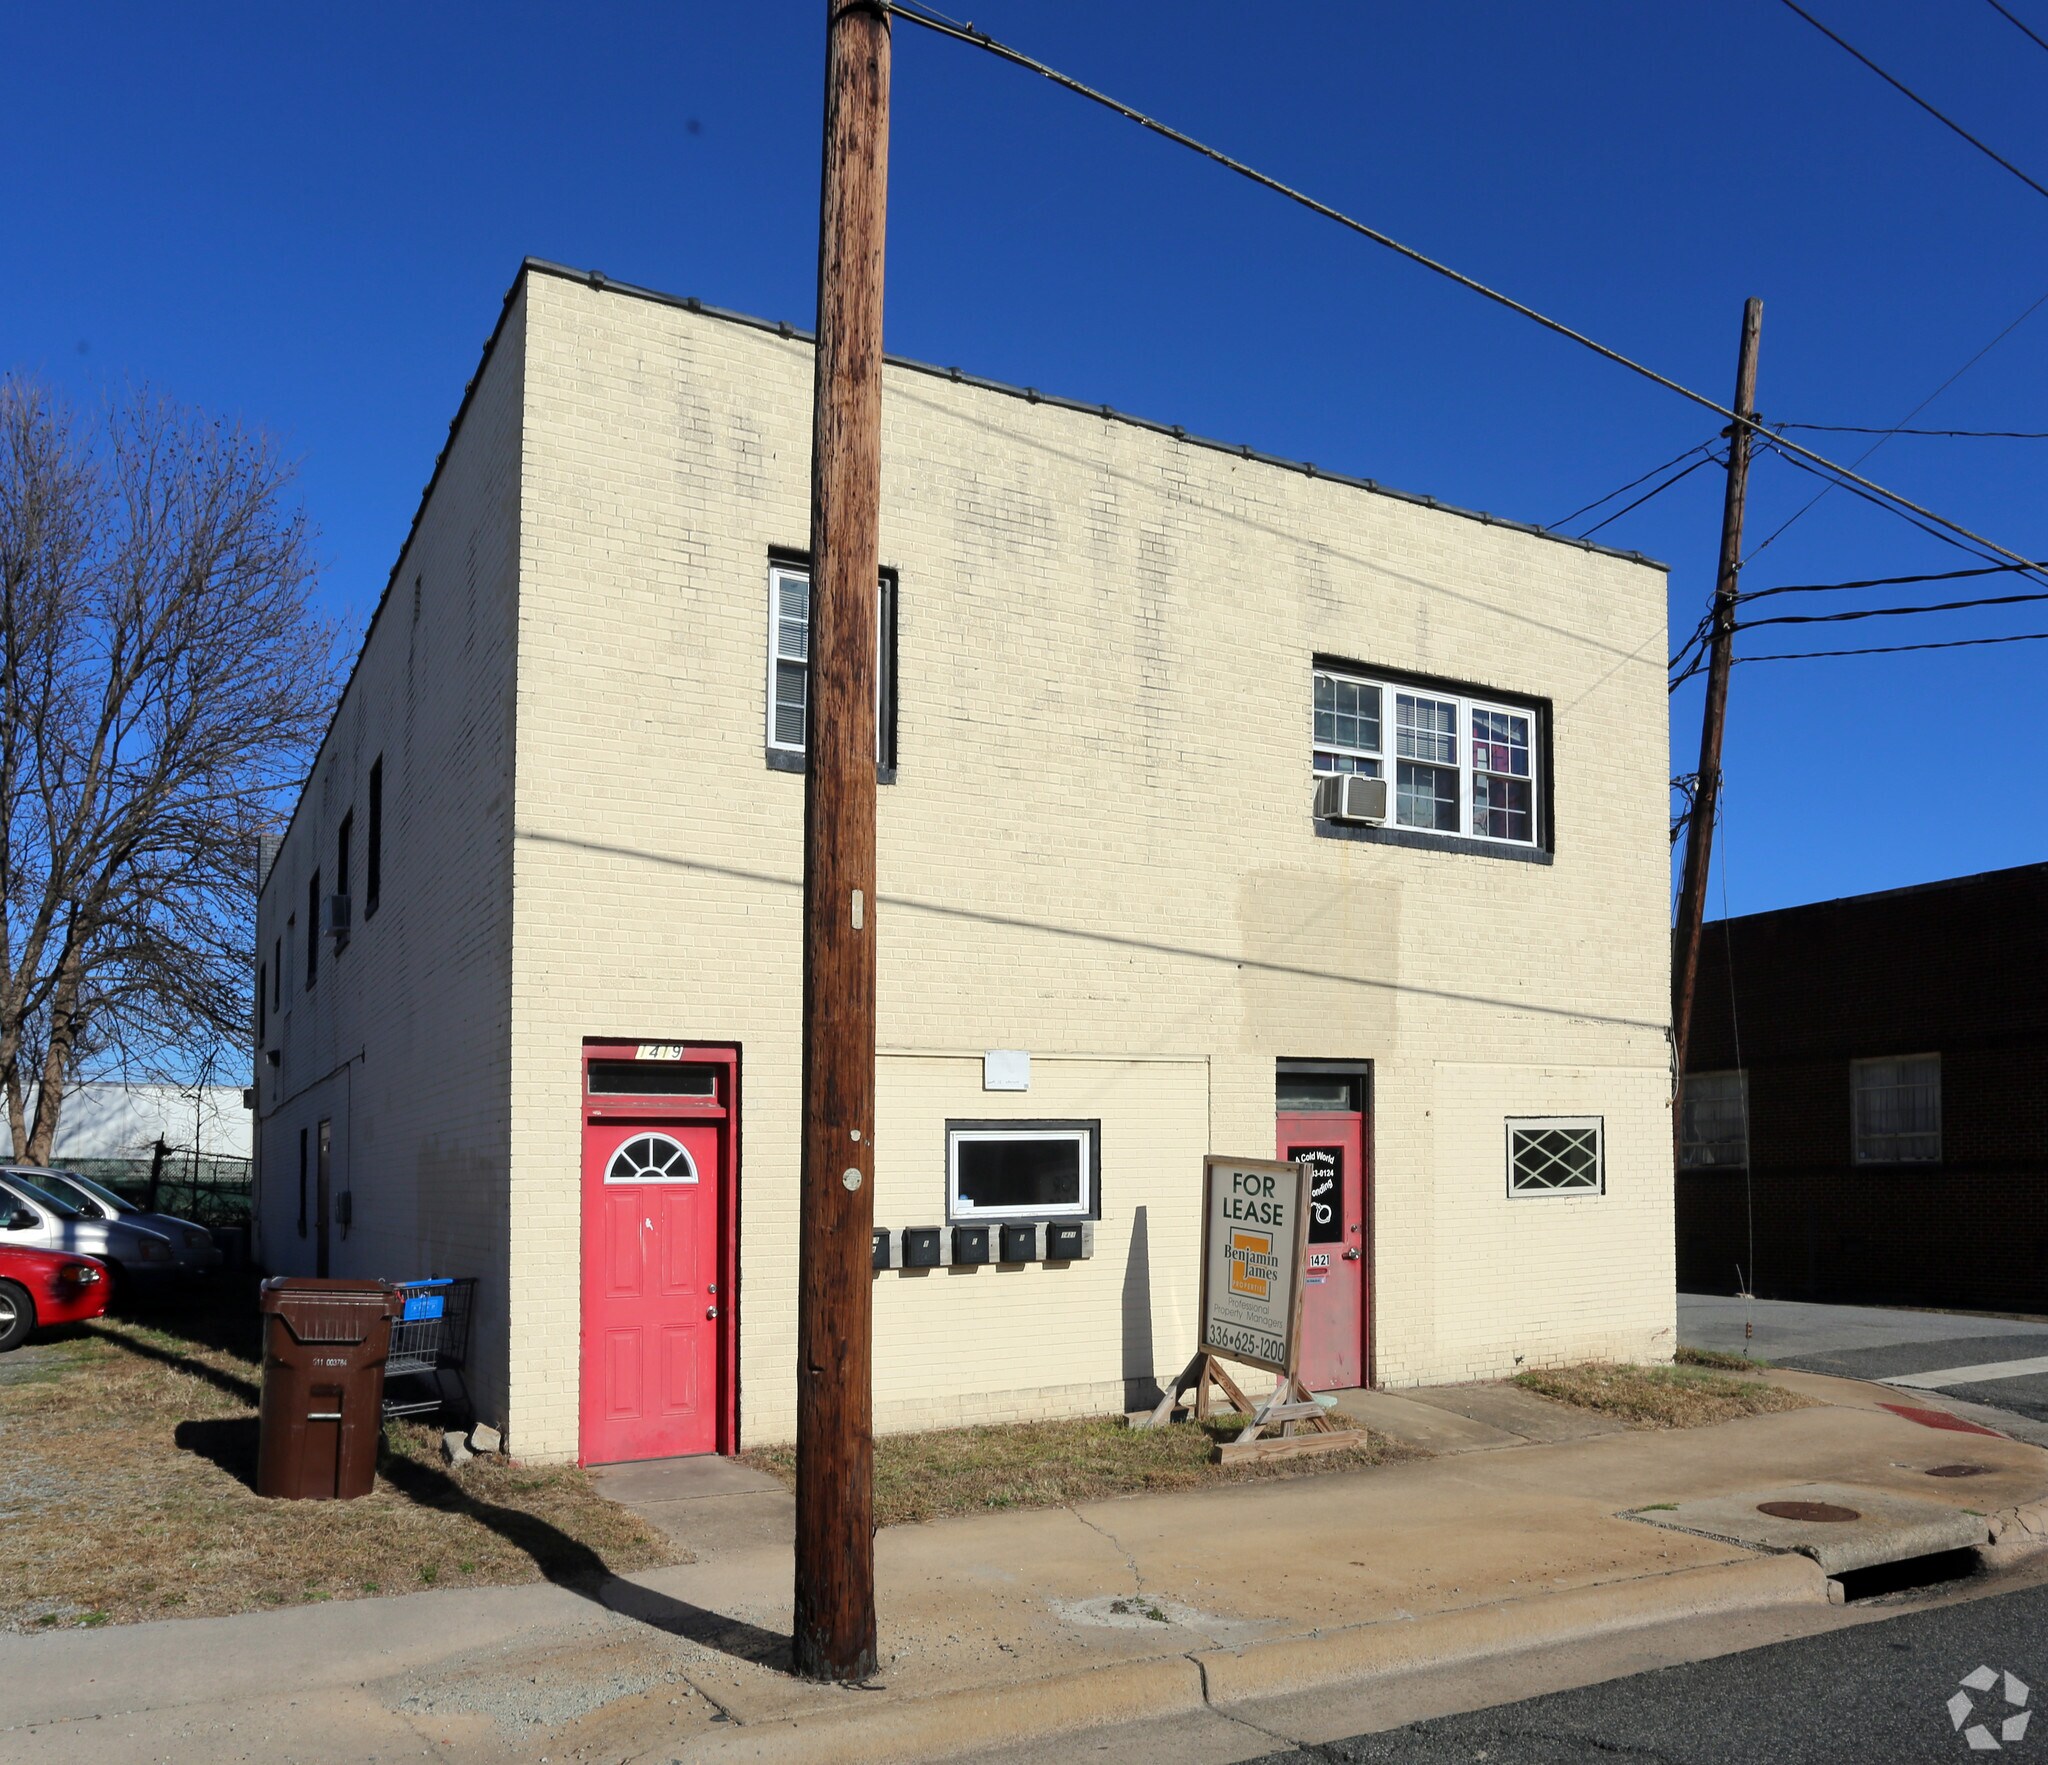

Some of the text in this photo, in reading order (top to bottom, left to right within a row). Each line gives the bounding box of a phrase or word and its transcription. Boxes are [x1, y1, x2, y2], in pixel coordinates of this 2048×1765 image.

[639, 1045, 682, 1059] 1419
[1300, 1151, 1316, 1163] Cold
[1316, 1151, 1335, 1165] World
[1233, 1172, 1276, 1199] FOR
[1312, 1178, 1334, 1197] onding
[1223, 1197, 1284, 1227] LEASE
[1224, 1244, 1279, 1268] Benjamin
[1310, 1254, 1330, 1266] 1421
[1244, 1263, 1278, 1281] James
[1232, 1280, 1266, 1294] PROPERTIES
[1228, 1297, 1270, 1314] Professional
[1213, 1303, 1283, 1329] Property Managers
